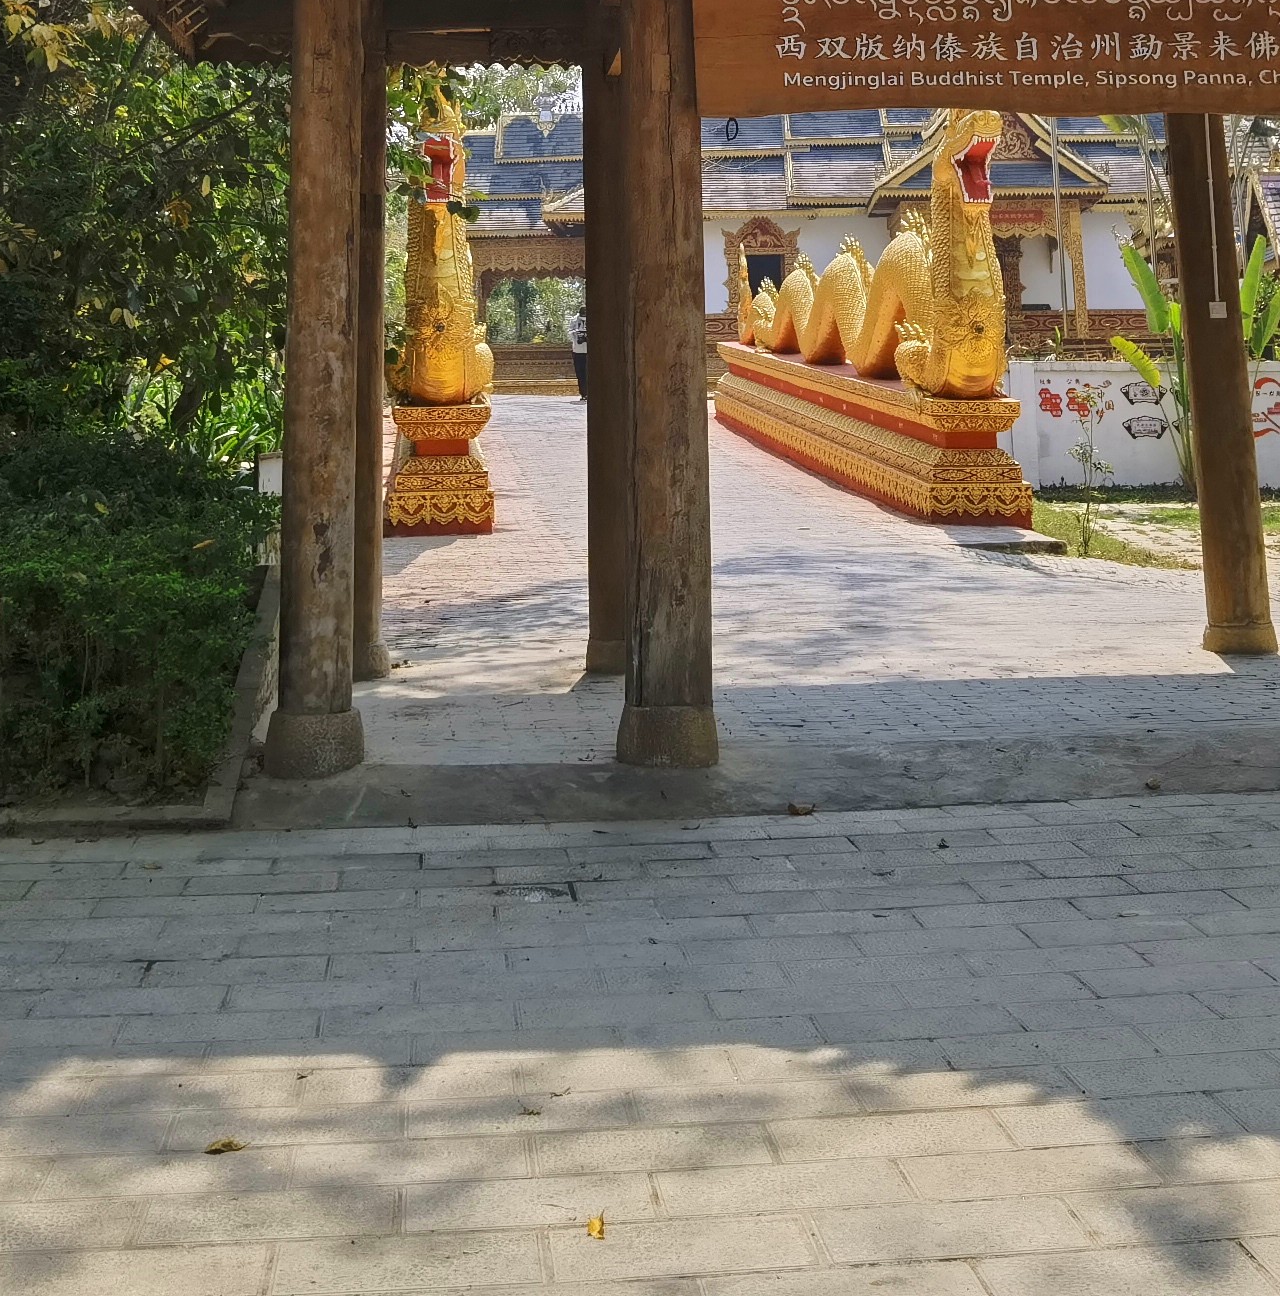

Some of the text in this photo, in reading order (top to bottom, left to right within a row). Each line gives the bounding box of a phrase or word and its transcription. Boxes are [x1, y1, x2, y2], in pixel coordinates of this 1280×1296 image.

[783, 71, 904, 90] Mengjinglai
[911, 71, 1003, 87] Buddhist
[1009, 70, 1089, 89] Temple,
[1096, 70, 1178, 89] Sipsong
[1184, 70, 1253, 87] Panna,
